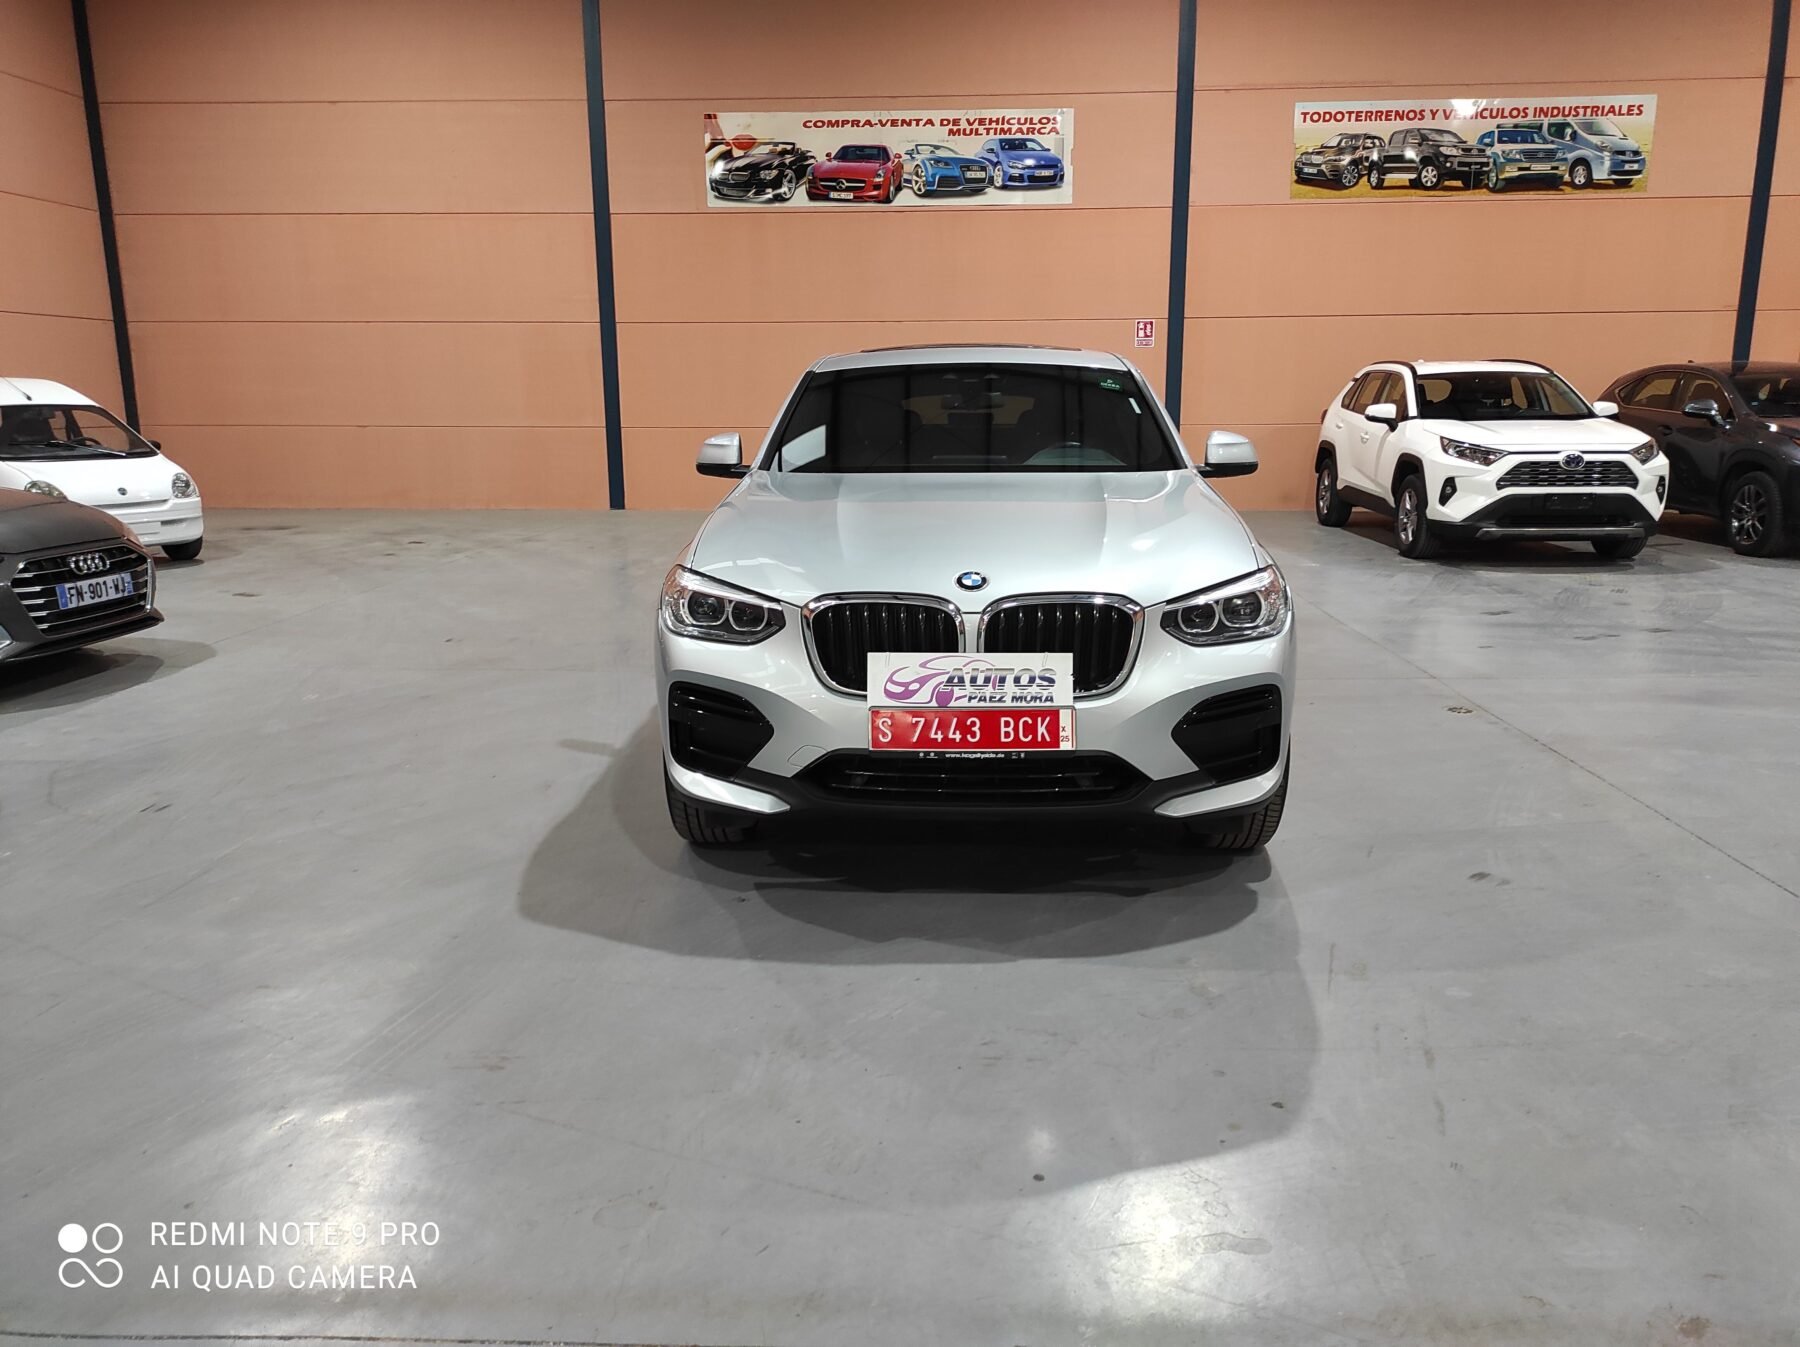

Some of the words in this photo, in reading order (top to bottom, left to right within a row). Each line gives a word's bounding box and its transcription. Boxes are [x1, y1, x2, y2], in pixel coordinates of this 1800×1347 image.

[1301, 109, 1425, 124] TODOTERRENOS
[1430, 108, 1439, 121] Y
[1443, 104, 1528, 120] VÍCULOS
[1533, 103, 1644, 119] INDUSTRIALES
[802, 117, 935, 129] COMPRA-VENTA
[940, 118, 961, 126] DE
[965, 115, 1060, 126] VEHÍCULOS
[947, 126, 1060, 136] MULTIMARCA
[941, 668, 1056, 691] AUTOS
[1010, 691, 1054, 704] MORA
[878, 717, 893, 743] S
[911, 717, 981, 743] 7443
[1000, 716, 1051, 743] BCK
[1060, 735, 1070, 743] 25
